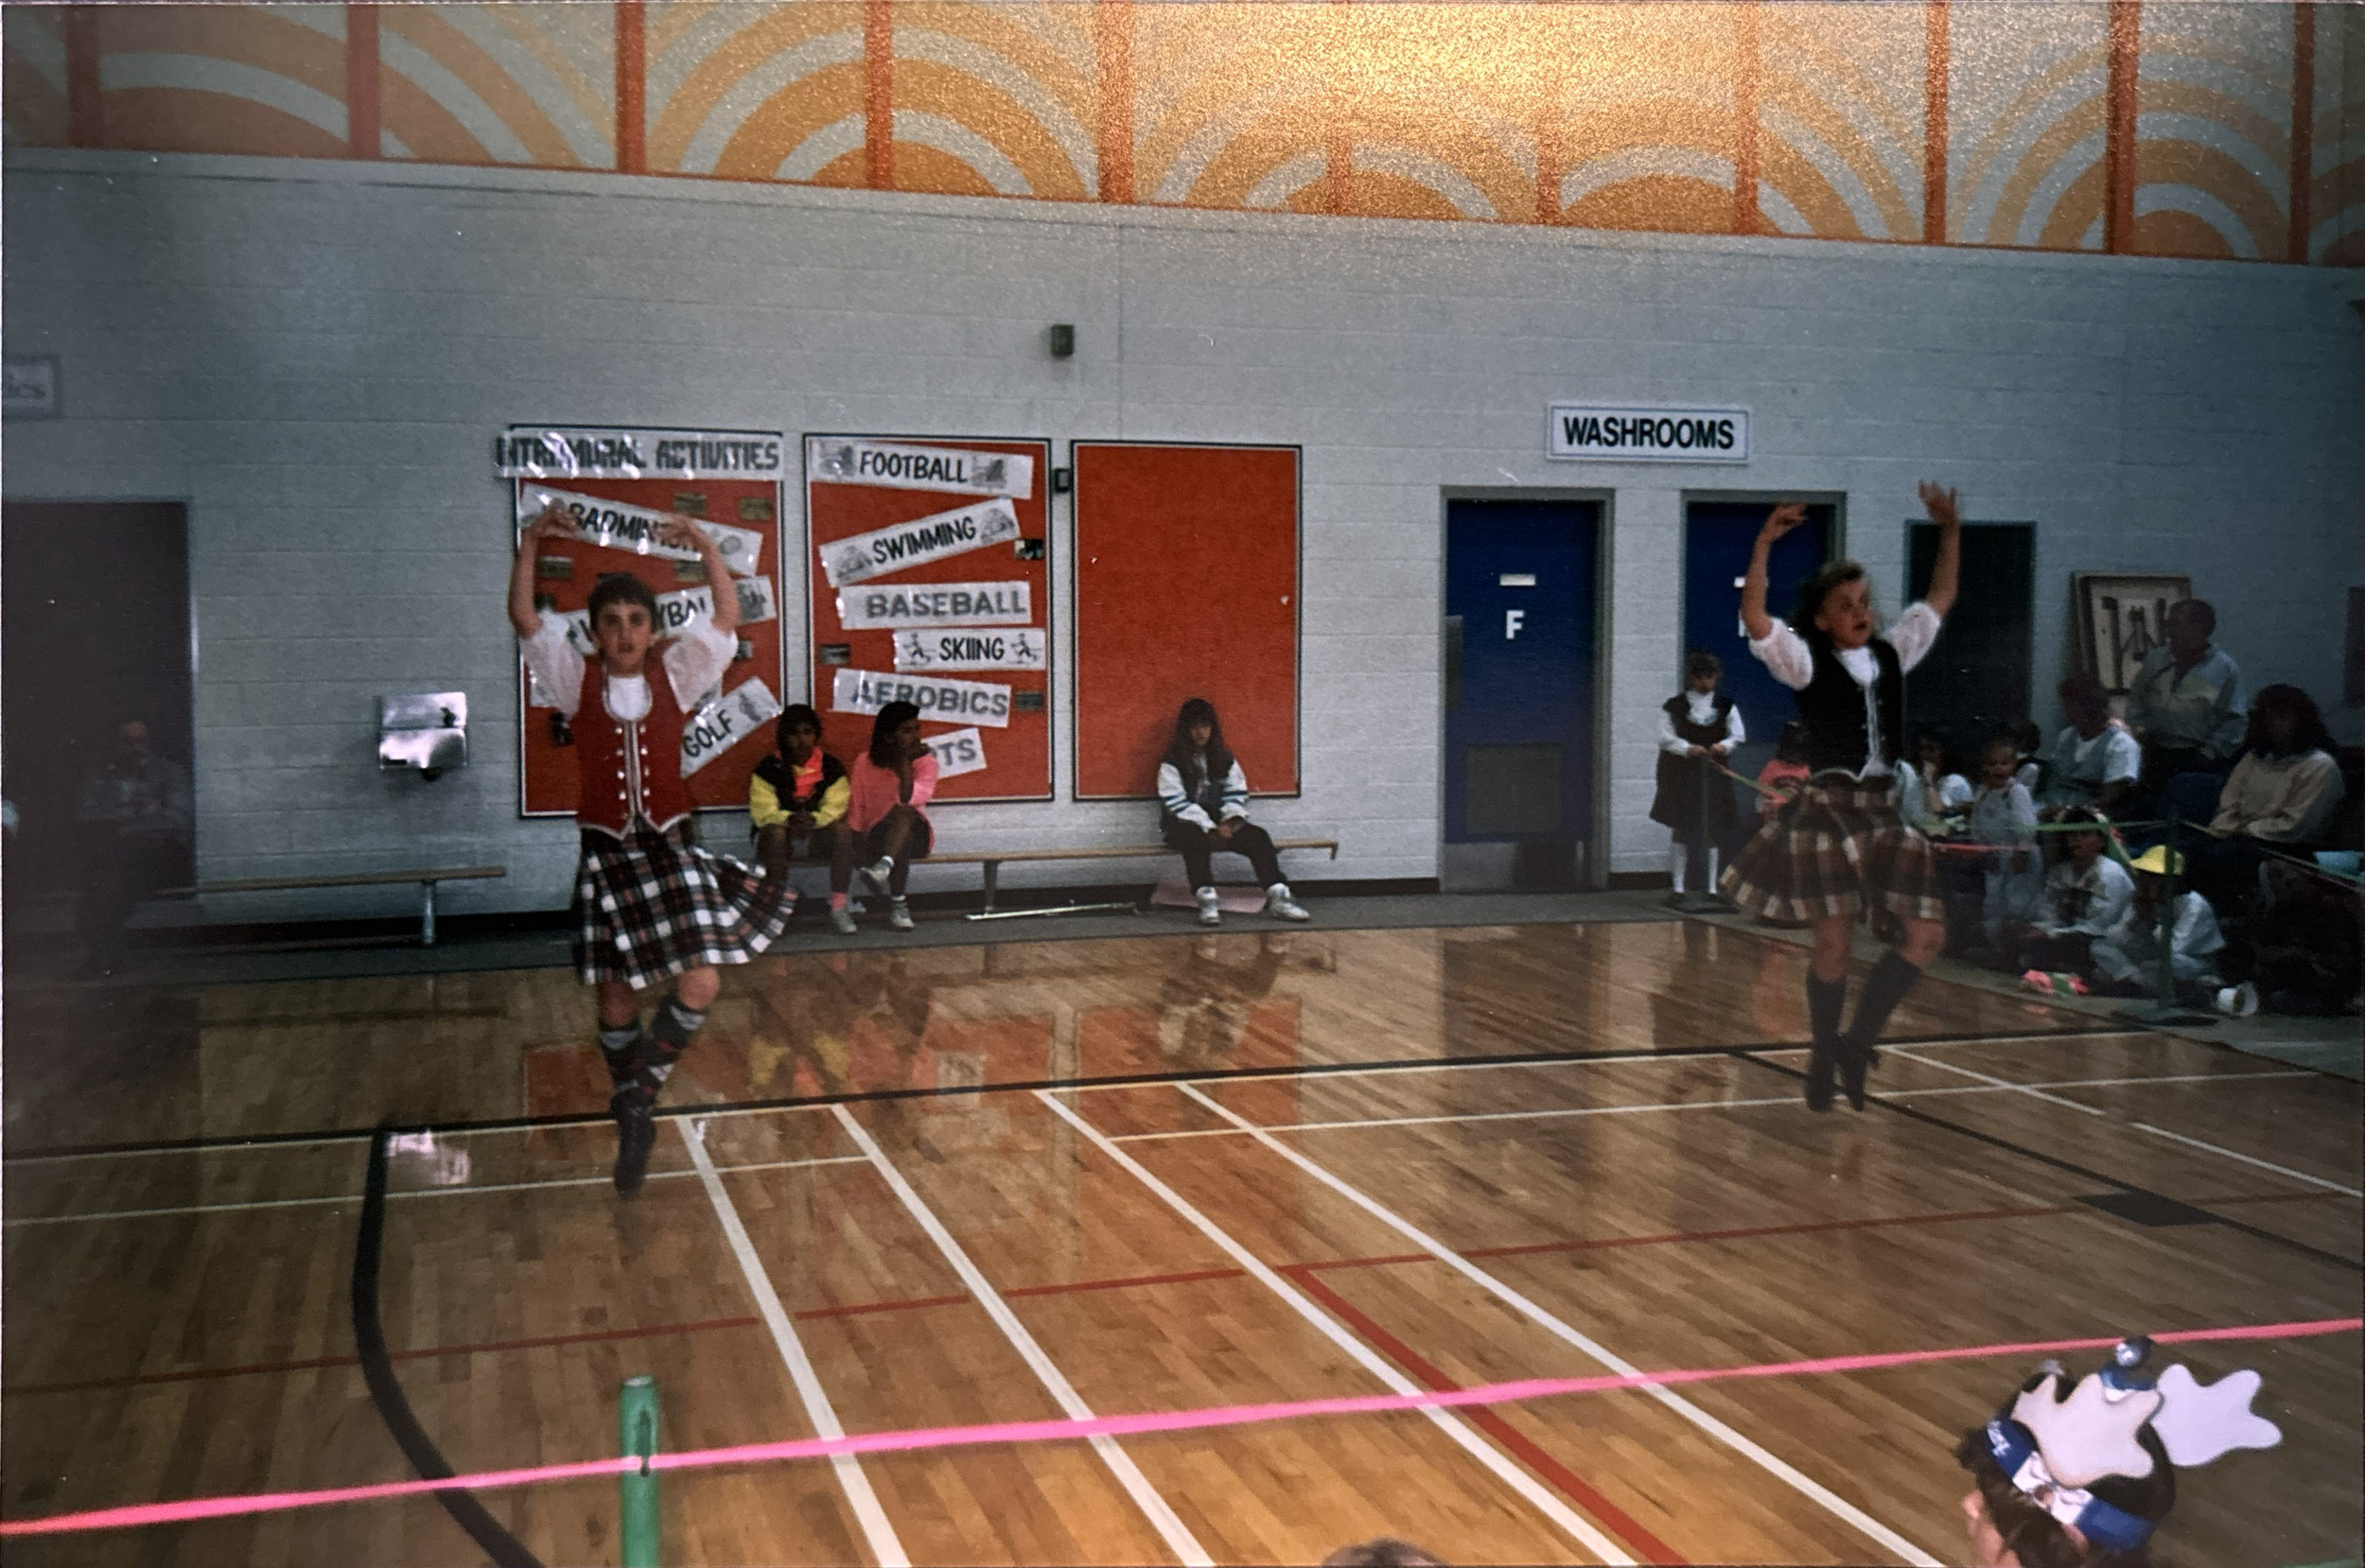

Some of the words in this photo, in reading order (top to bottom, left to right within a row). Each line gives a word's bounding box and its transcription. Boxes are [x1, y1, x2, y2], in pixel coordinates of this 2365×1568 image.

[1564, 416, 1734, 450] WASHROOMS
[497, 436, 646, 468] INTRMURAL
[656, 440, 780, 471] ACTIVITIES
[859, 450, 968, 483] FOOTBALL
[569, 502, 700, 553] BADMIN
[872, 515, 976, 565] SWIMMING
[865, 590, 1027, 619] BASEBALL
[1505, 609, 1525, 640] F
[938, 636, 1005, 661] SKIING
[851, 678, 1009, 717] AEROBICS
[682, 708, 732, 758] GOLF
